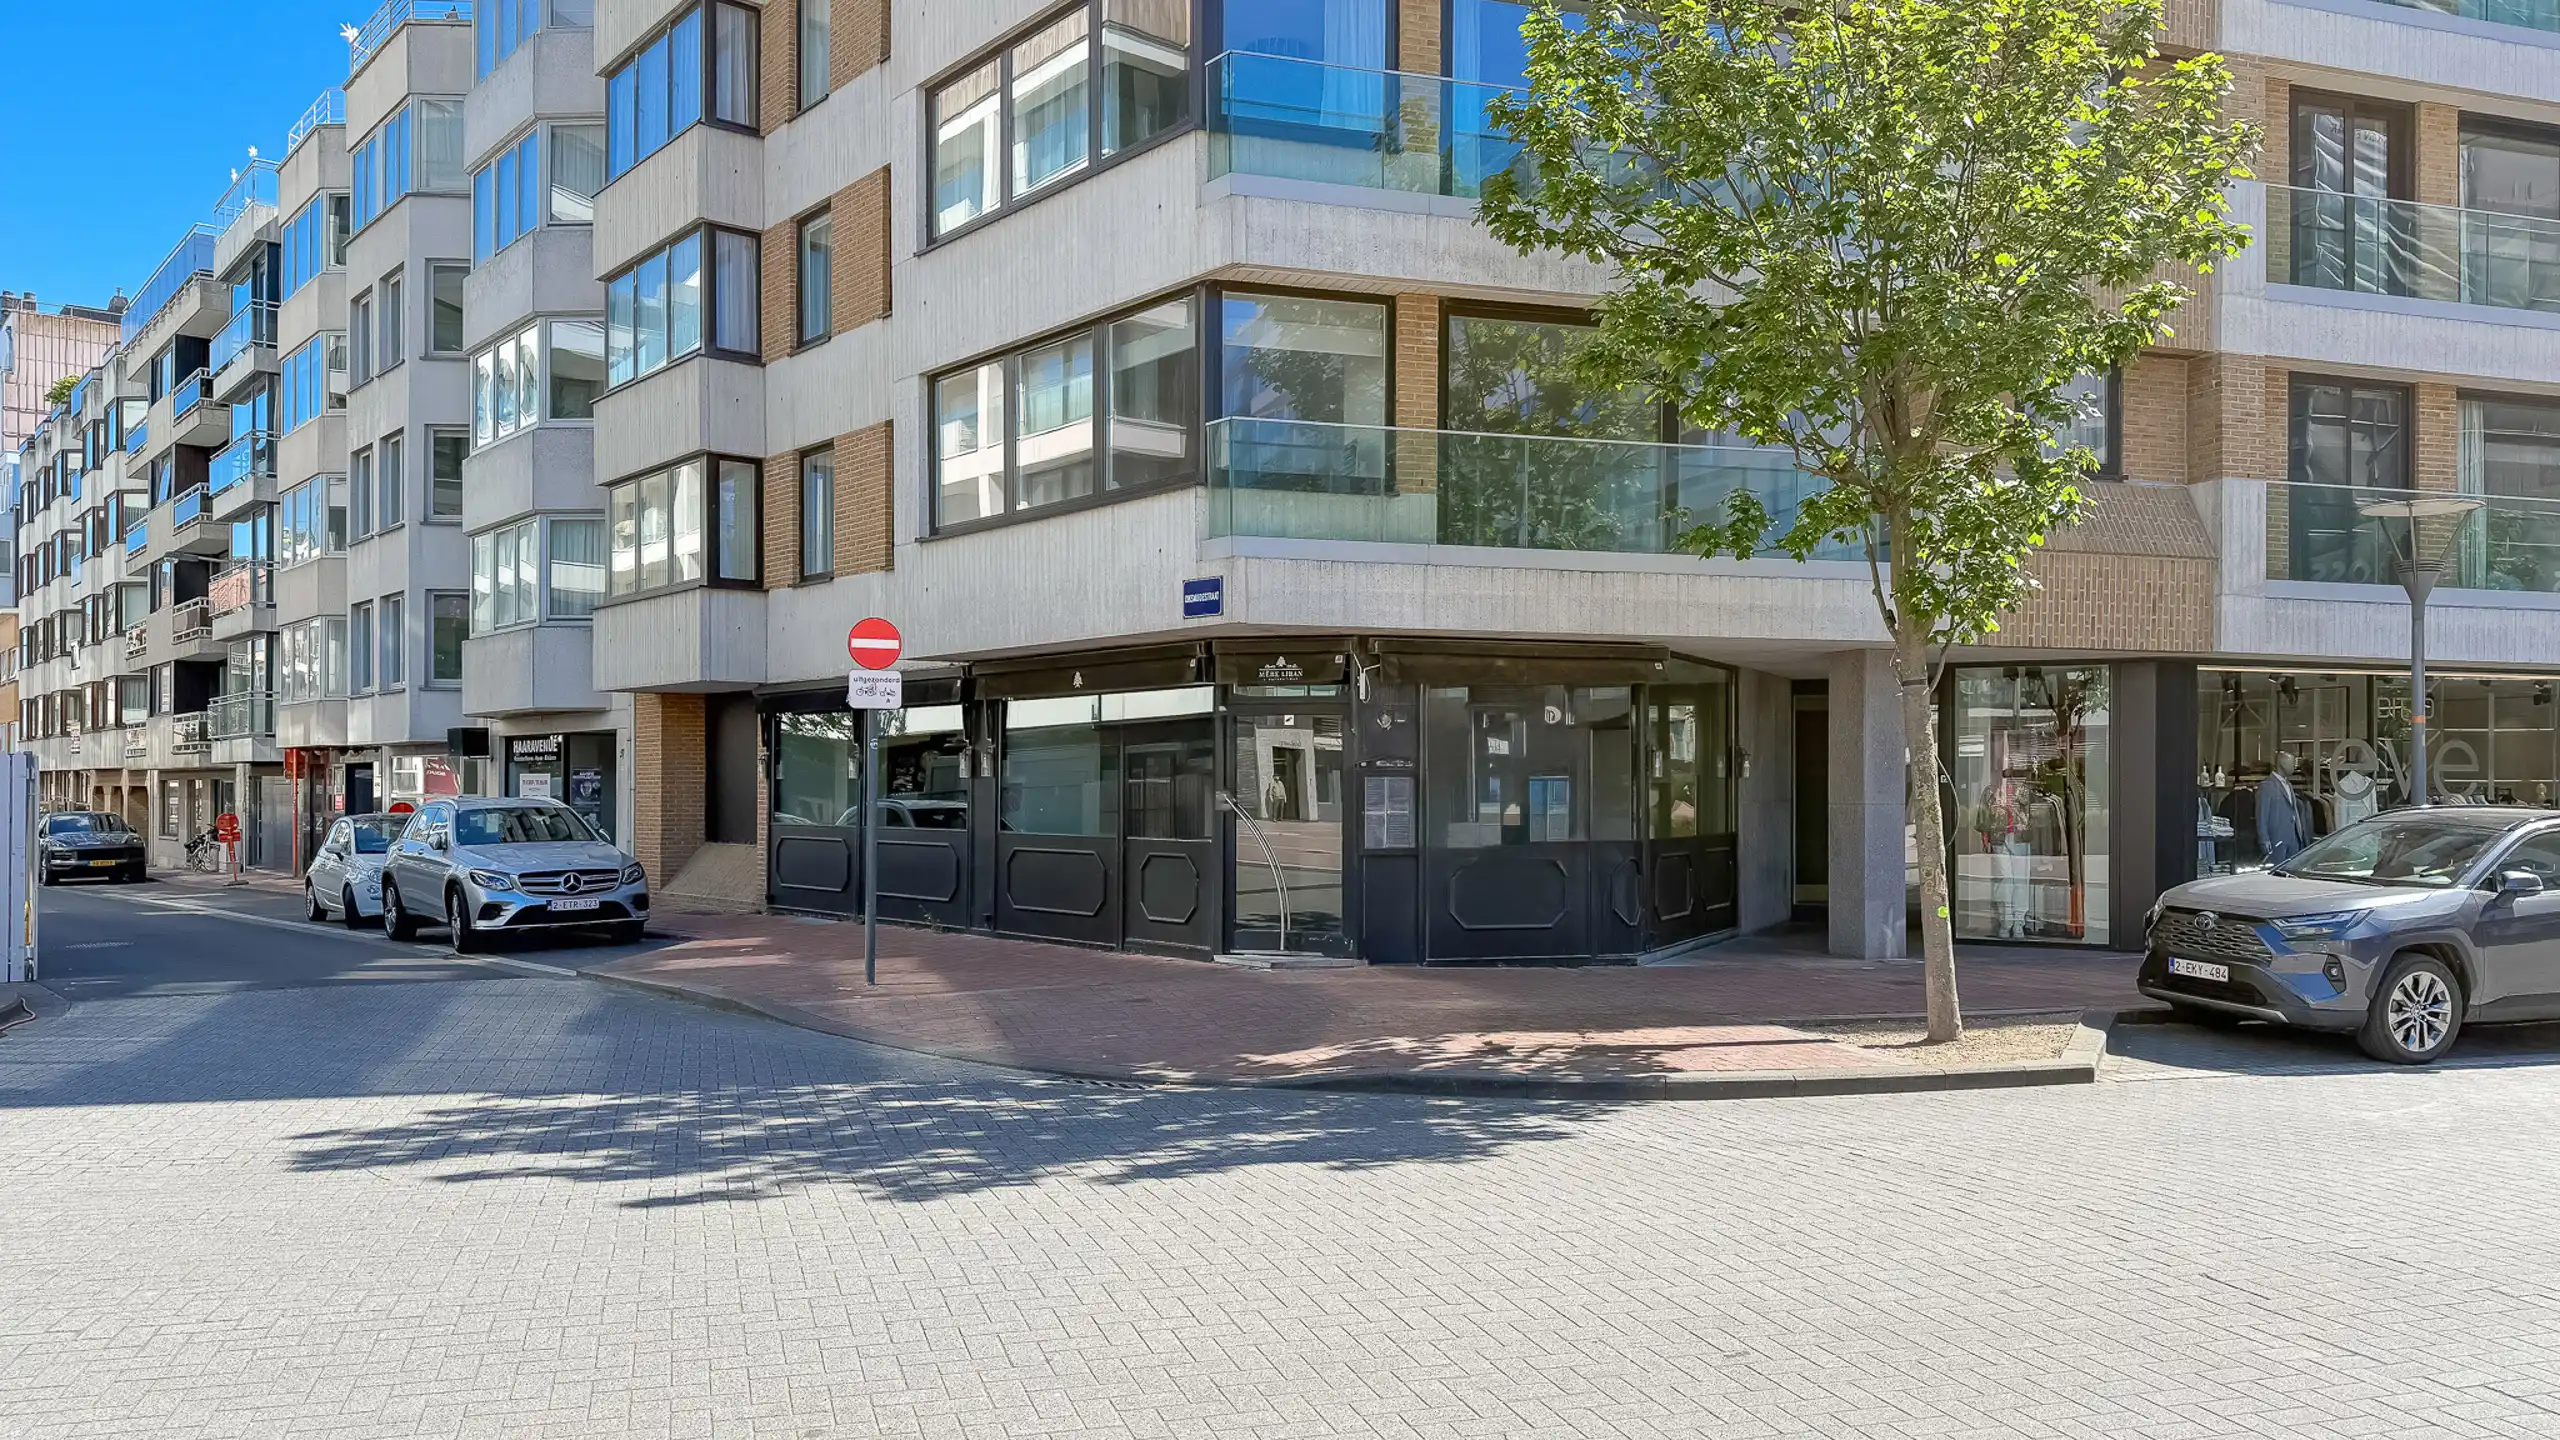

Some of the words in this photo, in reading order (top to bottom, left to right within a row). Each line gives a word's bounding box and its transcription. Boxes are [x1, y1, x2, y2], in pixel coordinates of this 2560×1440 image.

[853, 675, 900, 685] uitgezonderd
[553, 900, 598, 909] 2-ETR-323
[2175, 960, 2227, 980] 2-EKY-484
